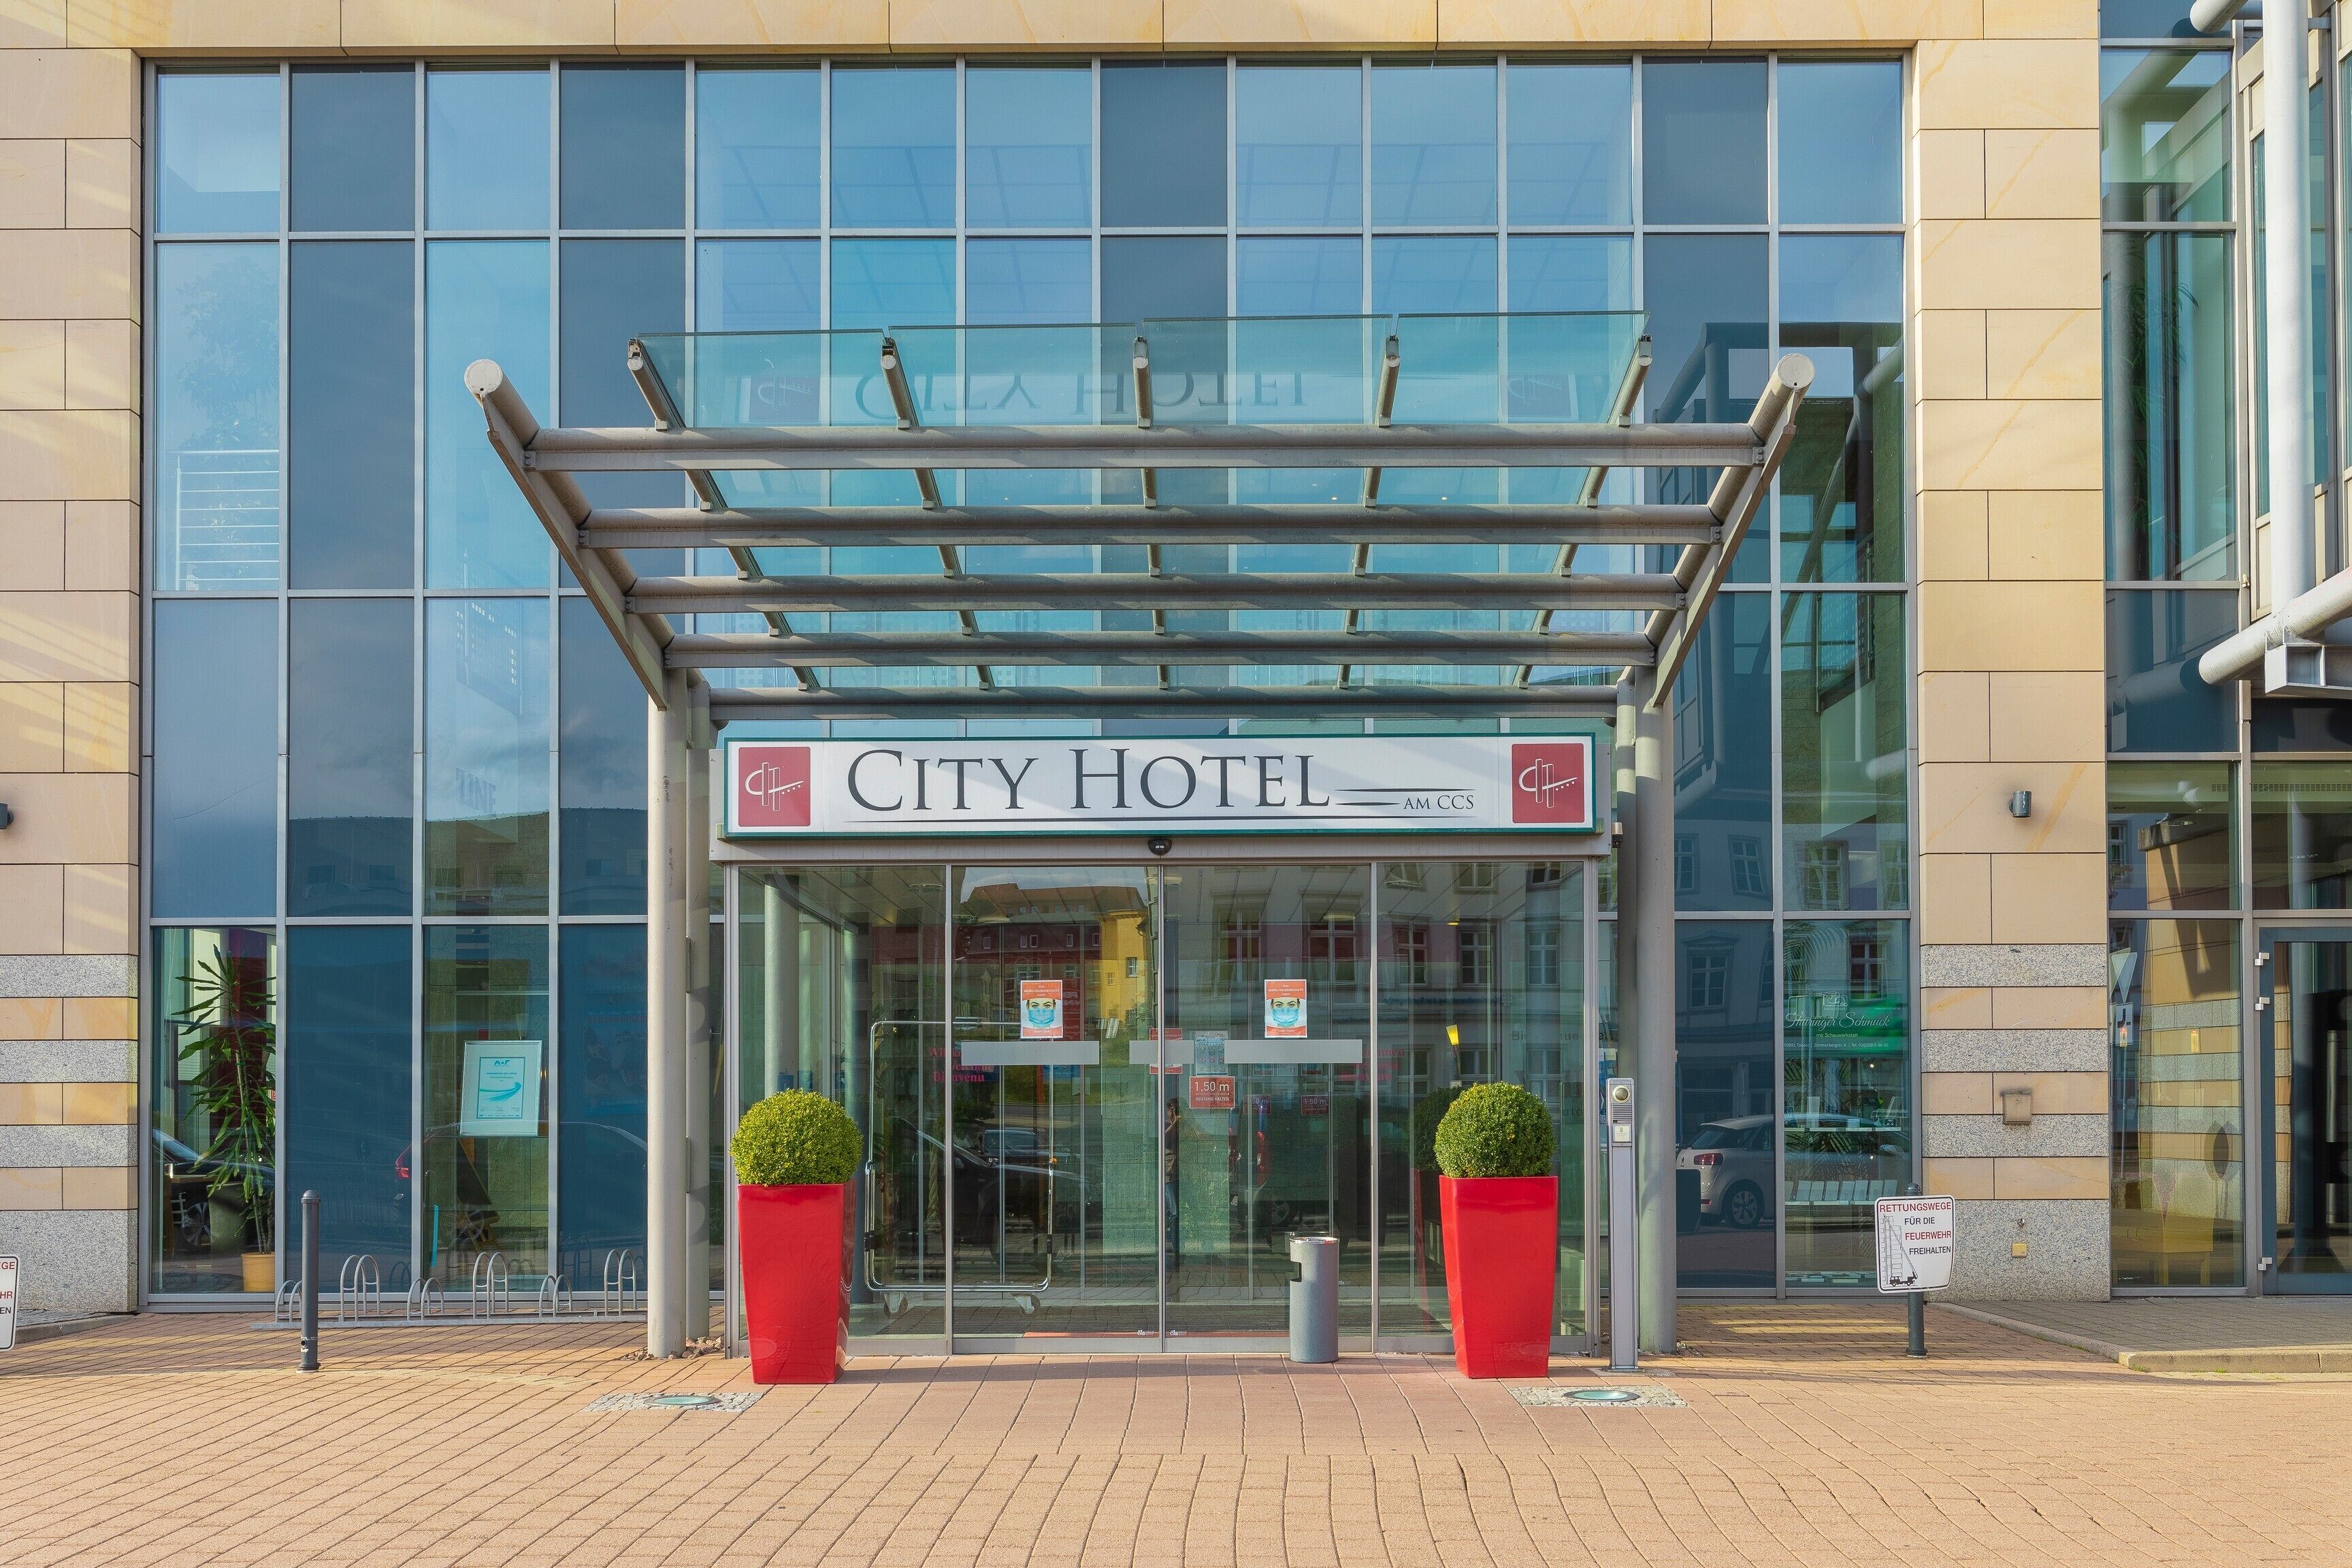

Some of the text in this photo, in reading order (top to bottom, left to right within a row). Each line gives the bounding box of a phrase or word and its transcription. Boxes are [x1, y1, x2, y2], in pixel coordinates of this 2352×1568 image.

[847, 748, 1330, 811] CITY HOTEL
[1403, 794, 1474, 810] AM CCS
[1784, 1012, 1890, 1031] Thüringer Schmuck
[1195, 1081, 1230, 1092] 1,50 m
[1880, 1202, 1951, 1212] RETTUNGSWEGE
[1904, 1216, 1921, 1225] FÜR
[1905, 1230, 1951, 1240] FEUERWEHR
[1909, 1246, 1951, 1255] FREIHALTEN
